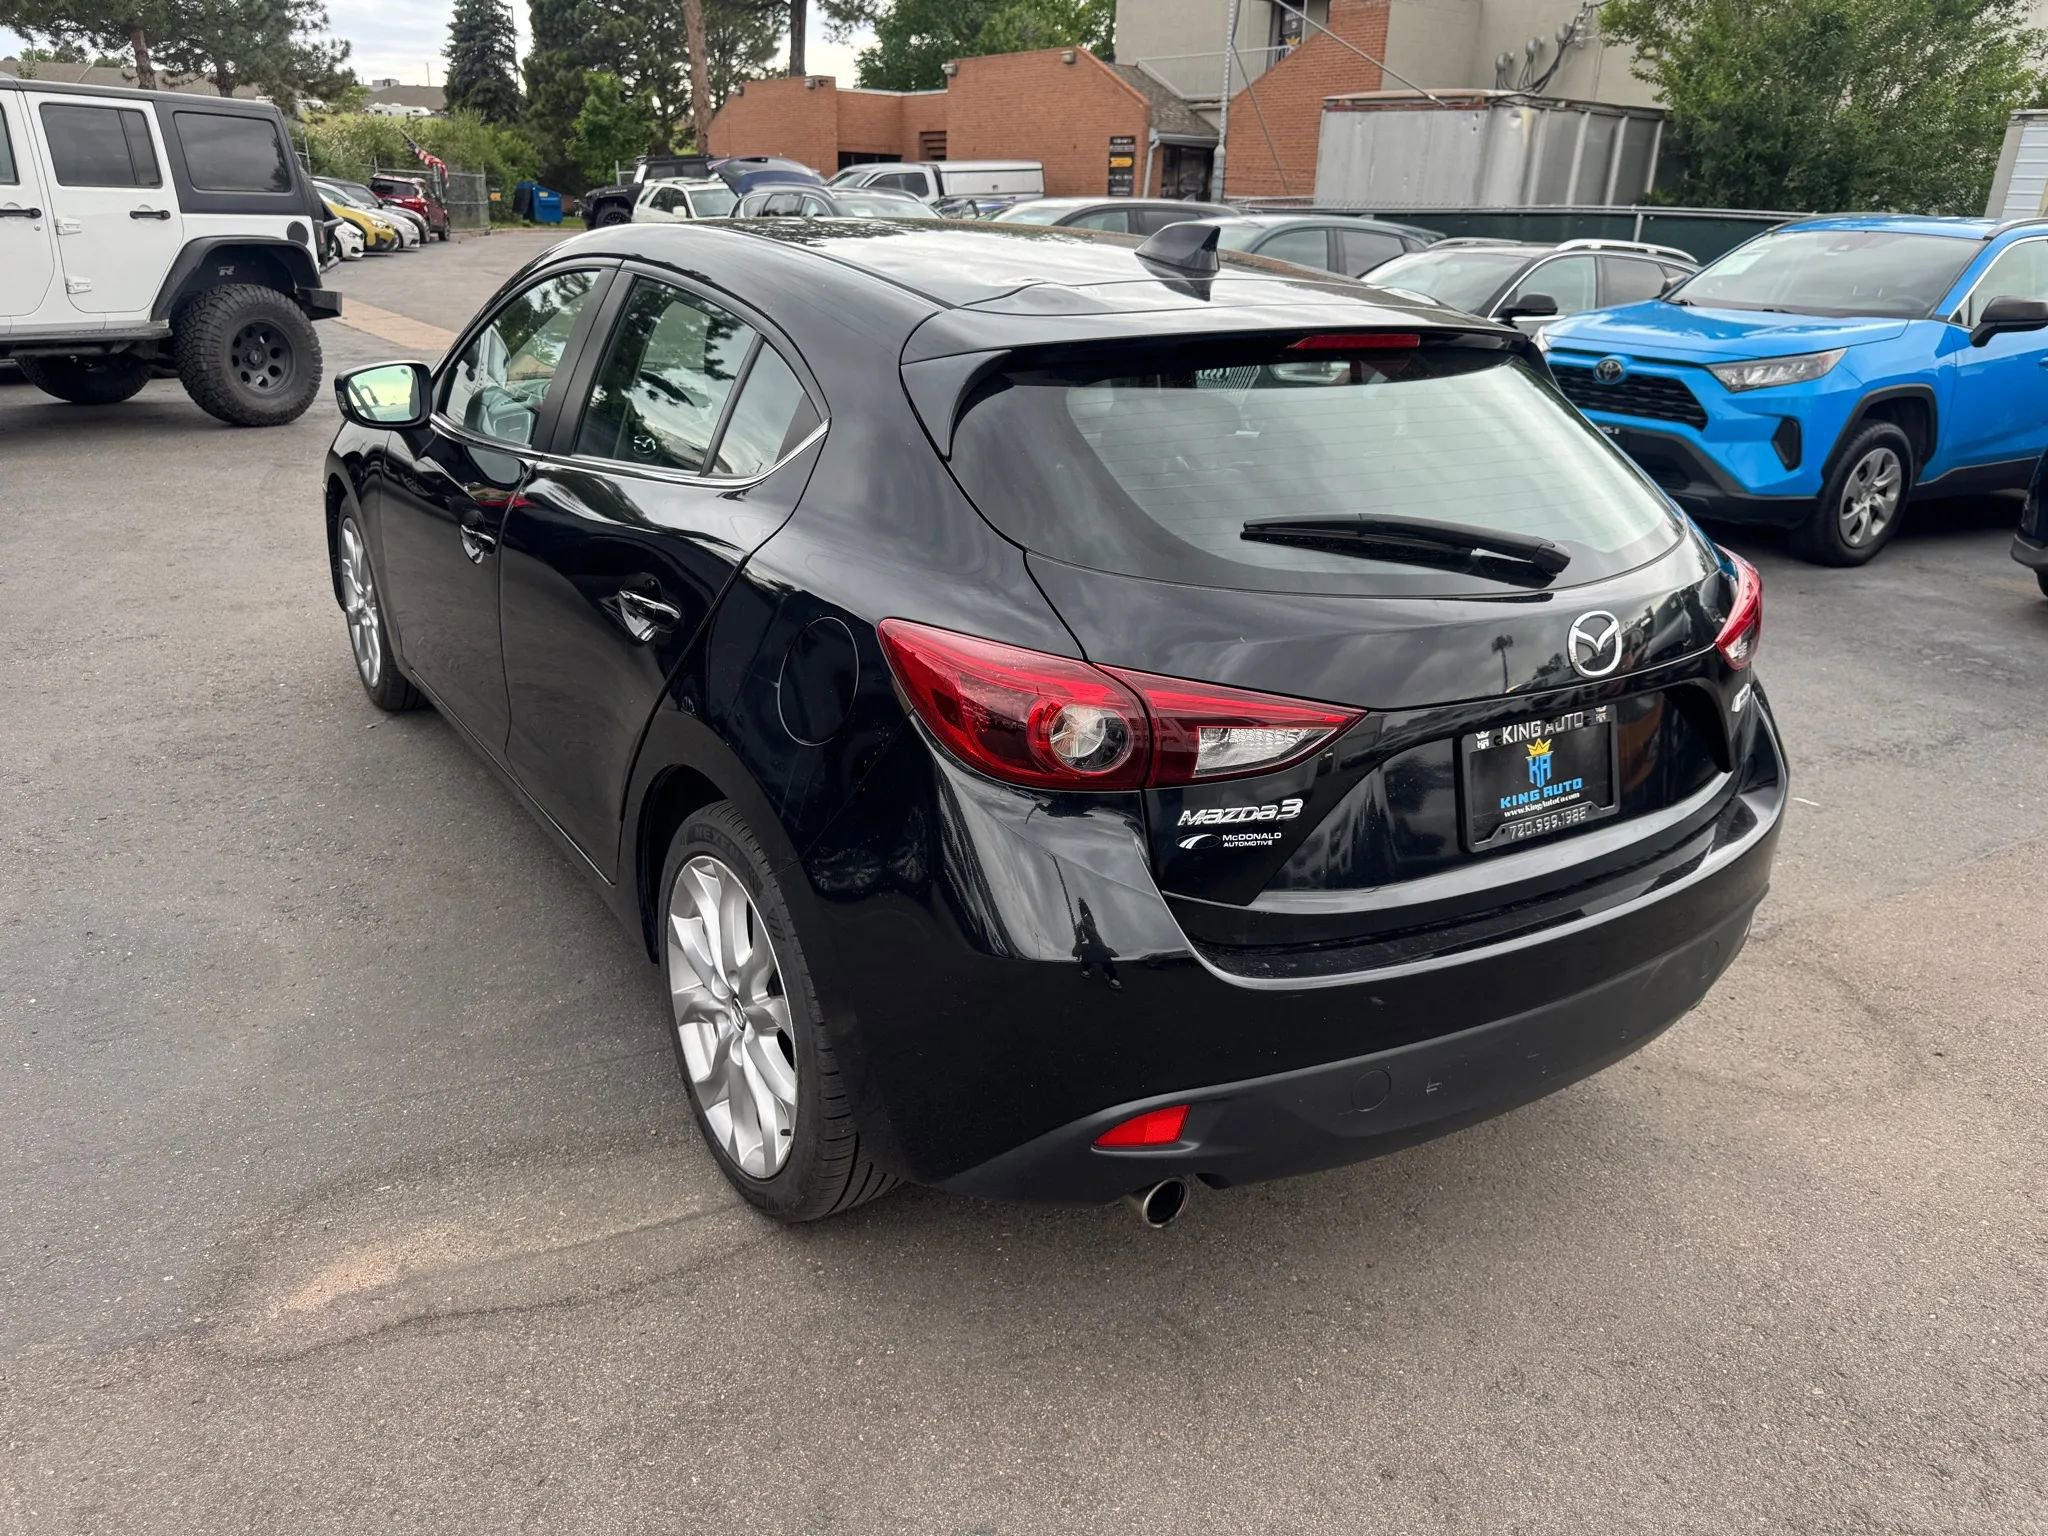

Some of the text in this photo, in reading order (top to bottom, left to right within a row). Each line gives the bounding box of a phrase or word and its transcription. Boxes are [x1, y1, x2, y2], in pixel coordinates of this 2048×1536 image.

[1502, 711, 1584, 745] KING AUTO
[1500, 777, 1583, 809] KING AUTO
[1222, 832, 1282, 841] McDONALD
[1223, 839, 1273, 847] AUTOMOTIVE
